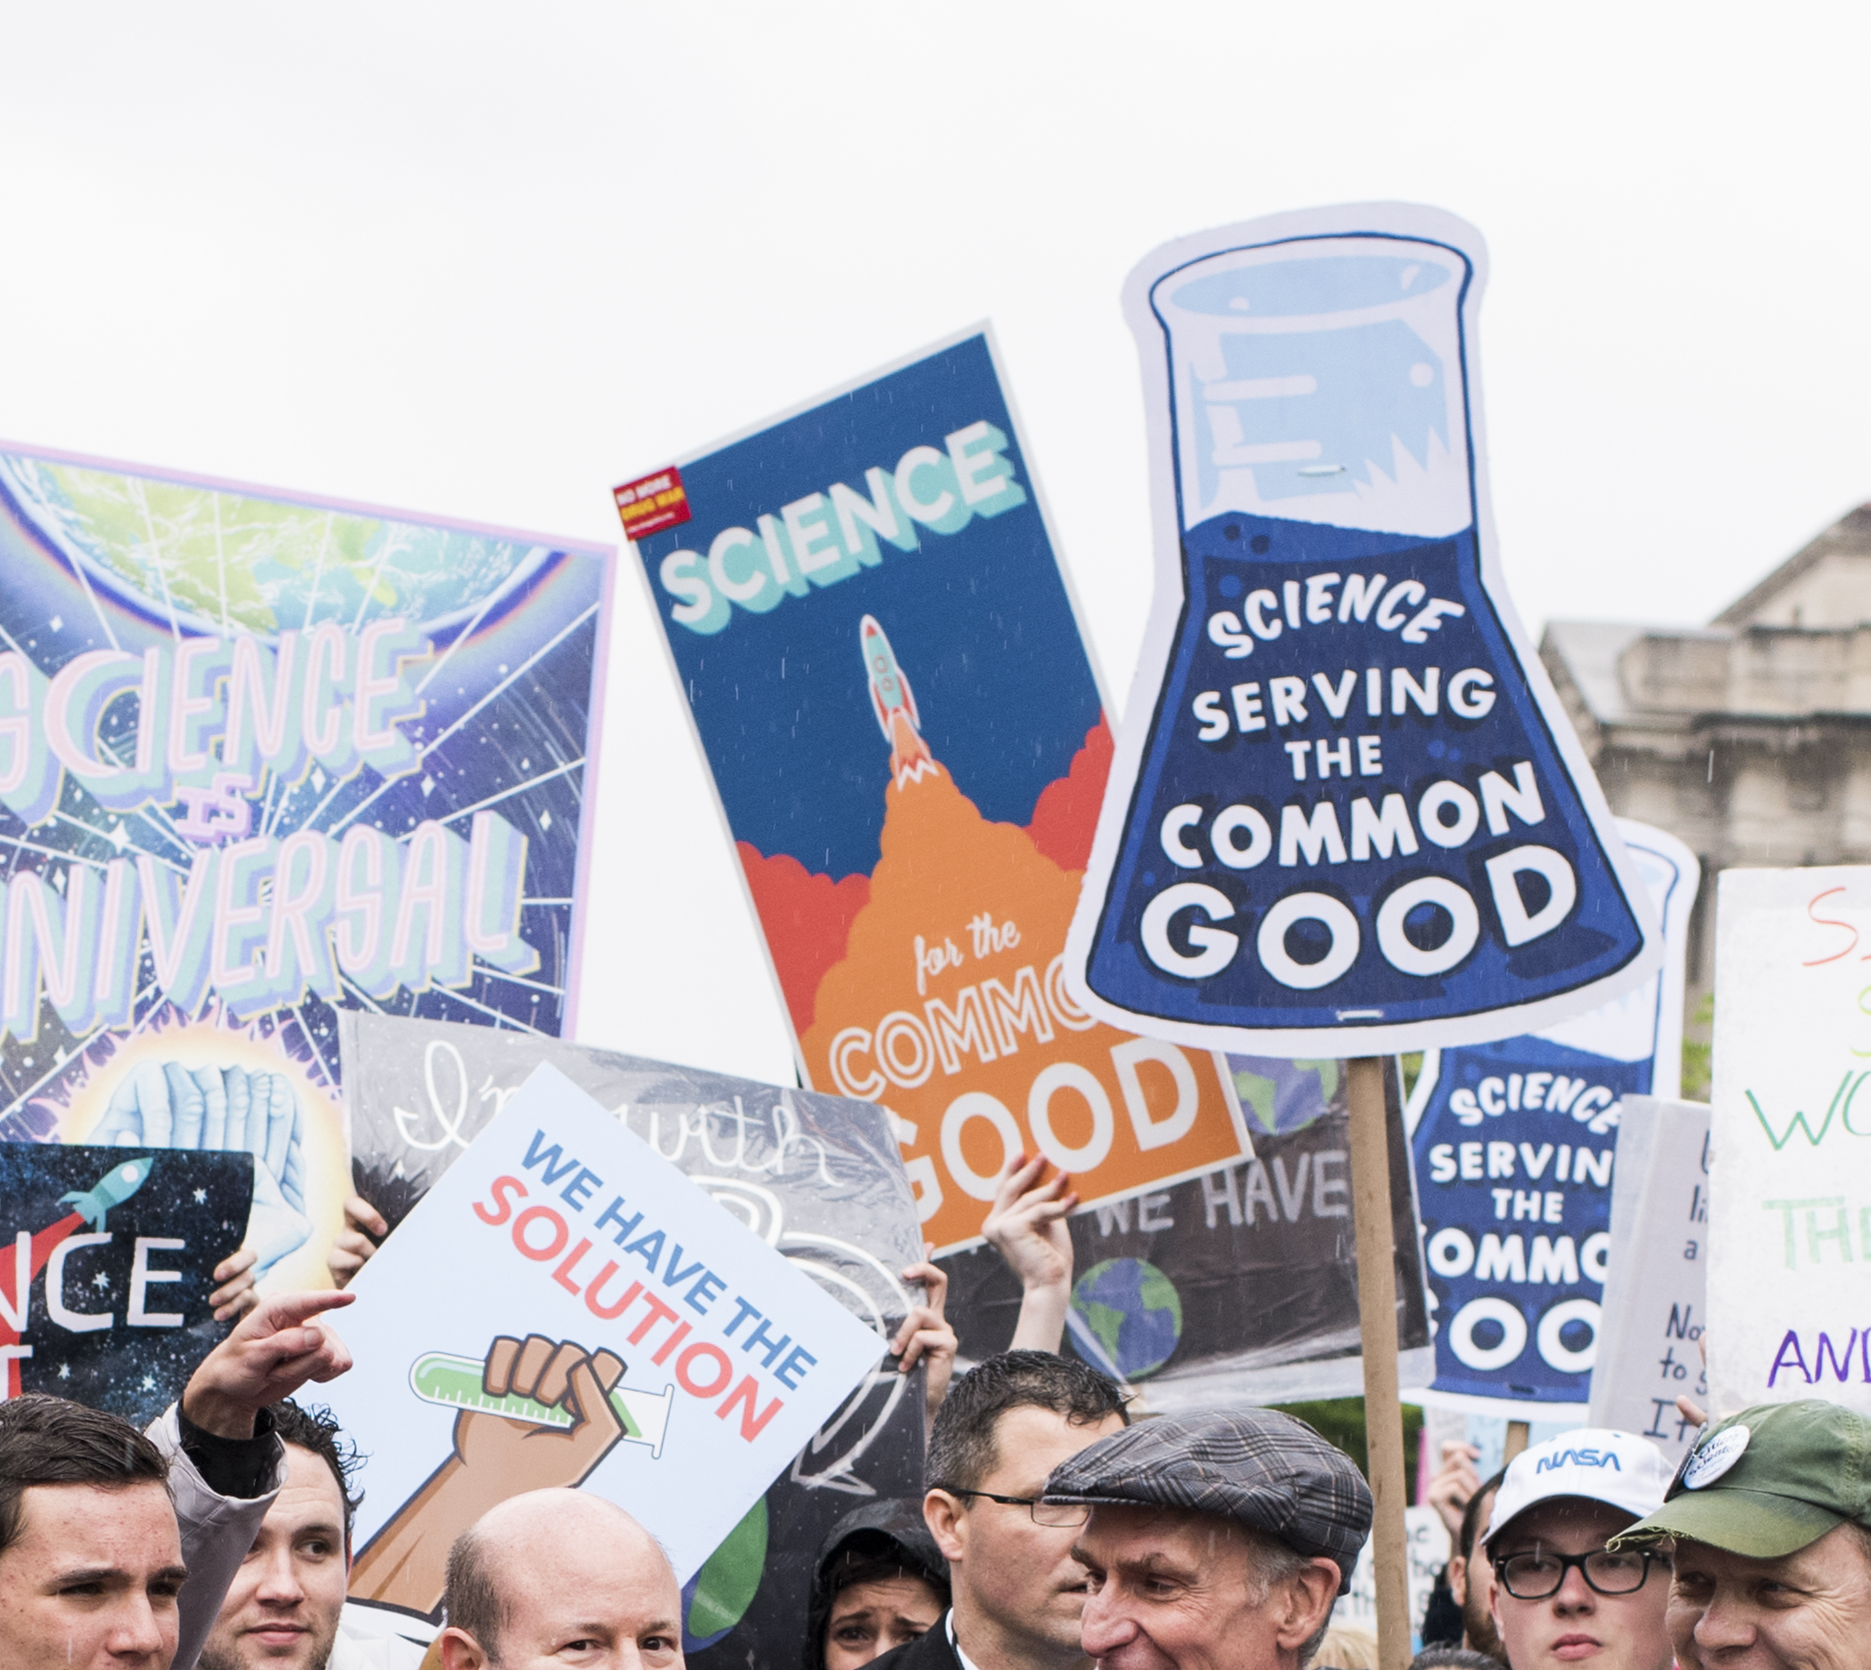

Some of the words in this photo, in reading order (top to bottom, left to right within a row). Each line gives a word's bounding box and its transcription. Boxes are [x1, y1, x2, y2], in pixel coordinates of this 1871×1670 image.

[660, 419, 1022, 630] SCIENCE
[1209, 572, 1464, 660] SCIENCE
[1193, 667, 1496, 743] SERVING
[1285, 735, 1382, 781] THE
[173, 772, 253, 843] IS
[1159, 760, 1545, 869] COMMON
[914, 934, 963, 996] for
[966, 912, 1021, 960] the
[1140, 843, 1576, 990] GOOD
[829, 952, 1099, 1101] COMMO
[1450, 1072, 1622, 1136] SCIENCE
[1201, 1150, 1349, 1229] HAVE
[1430, 1140, 1613, 1188] SERVIN
[1491, 1187, 1564, 1224] THE
[521, 1129, 604, 1213] WE
[593, 1196, 727, 1316] HAVE
[733, 1296, 818, 1390] THE
[1420, 1224, 1612, 1286] OMMO
[472, 1175, 785, 1443] SOLUTION
[1428, 1286, 1603, 1374] OO
[1536, 1448, 1623, 1475] NASA
